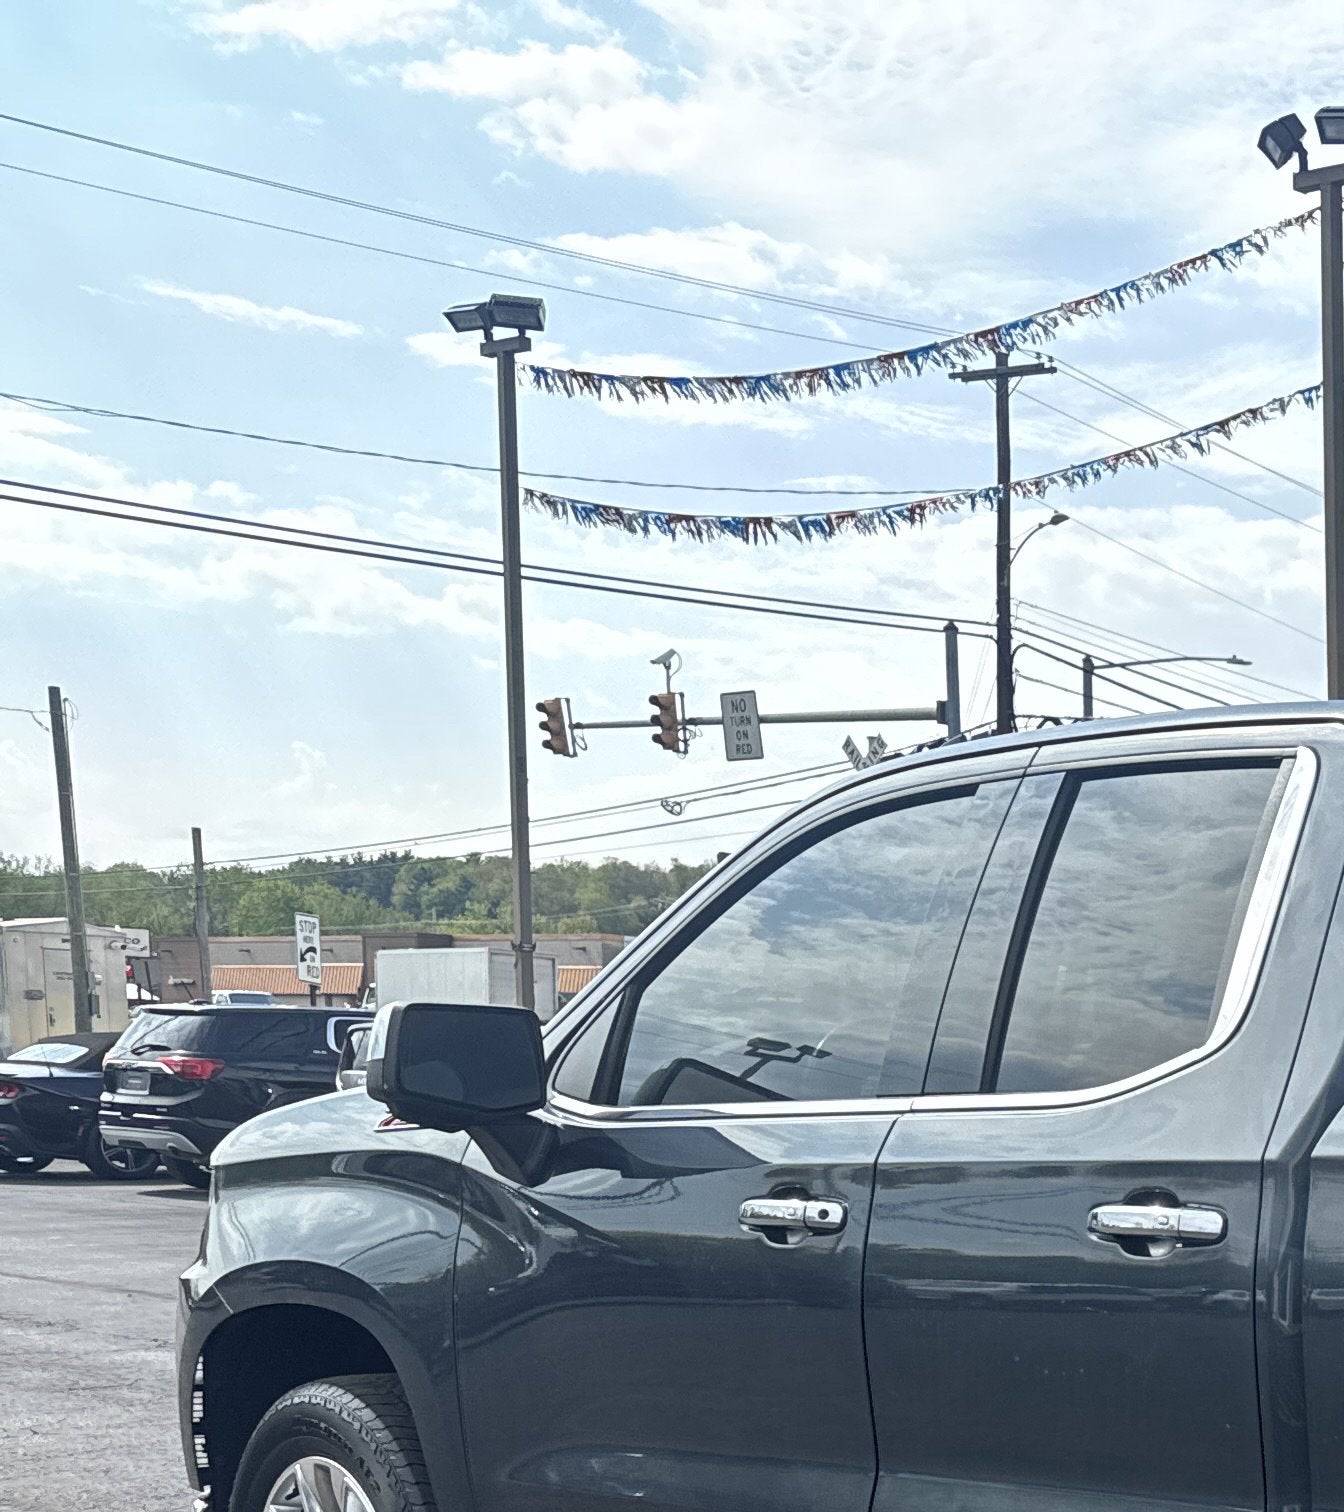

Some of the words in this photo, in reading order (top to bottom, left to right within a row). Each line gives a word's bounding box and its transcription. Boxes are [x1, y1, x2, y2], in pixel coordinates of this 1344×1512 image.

[730, 698, 747, 714] NO
[729, 714, 752, 727] TURN
[735, 729, 749, 741] ON
[735, 743, 753, 755] RED
[298, 919, 317, 934] STOP
[306, 964, 320, 979] RED
